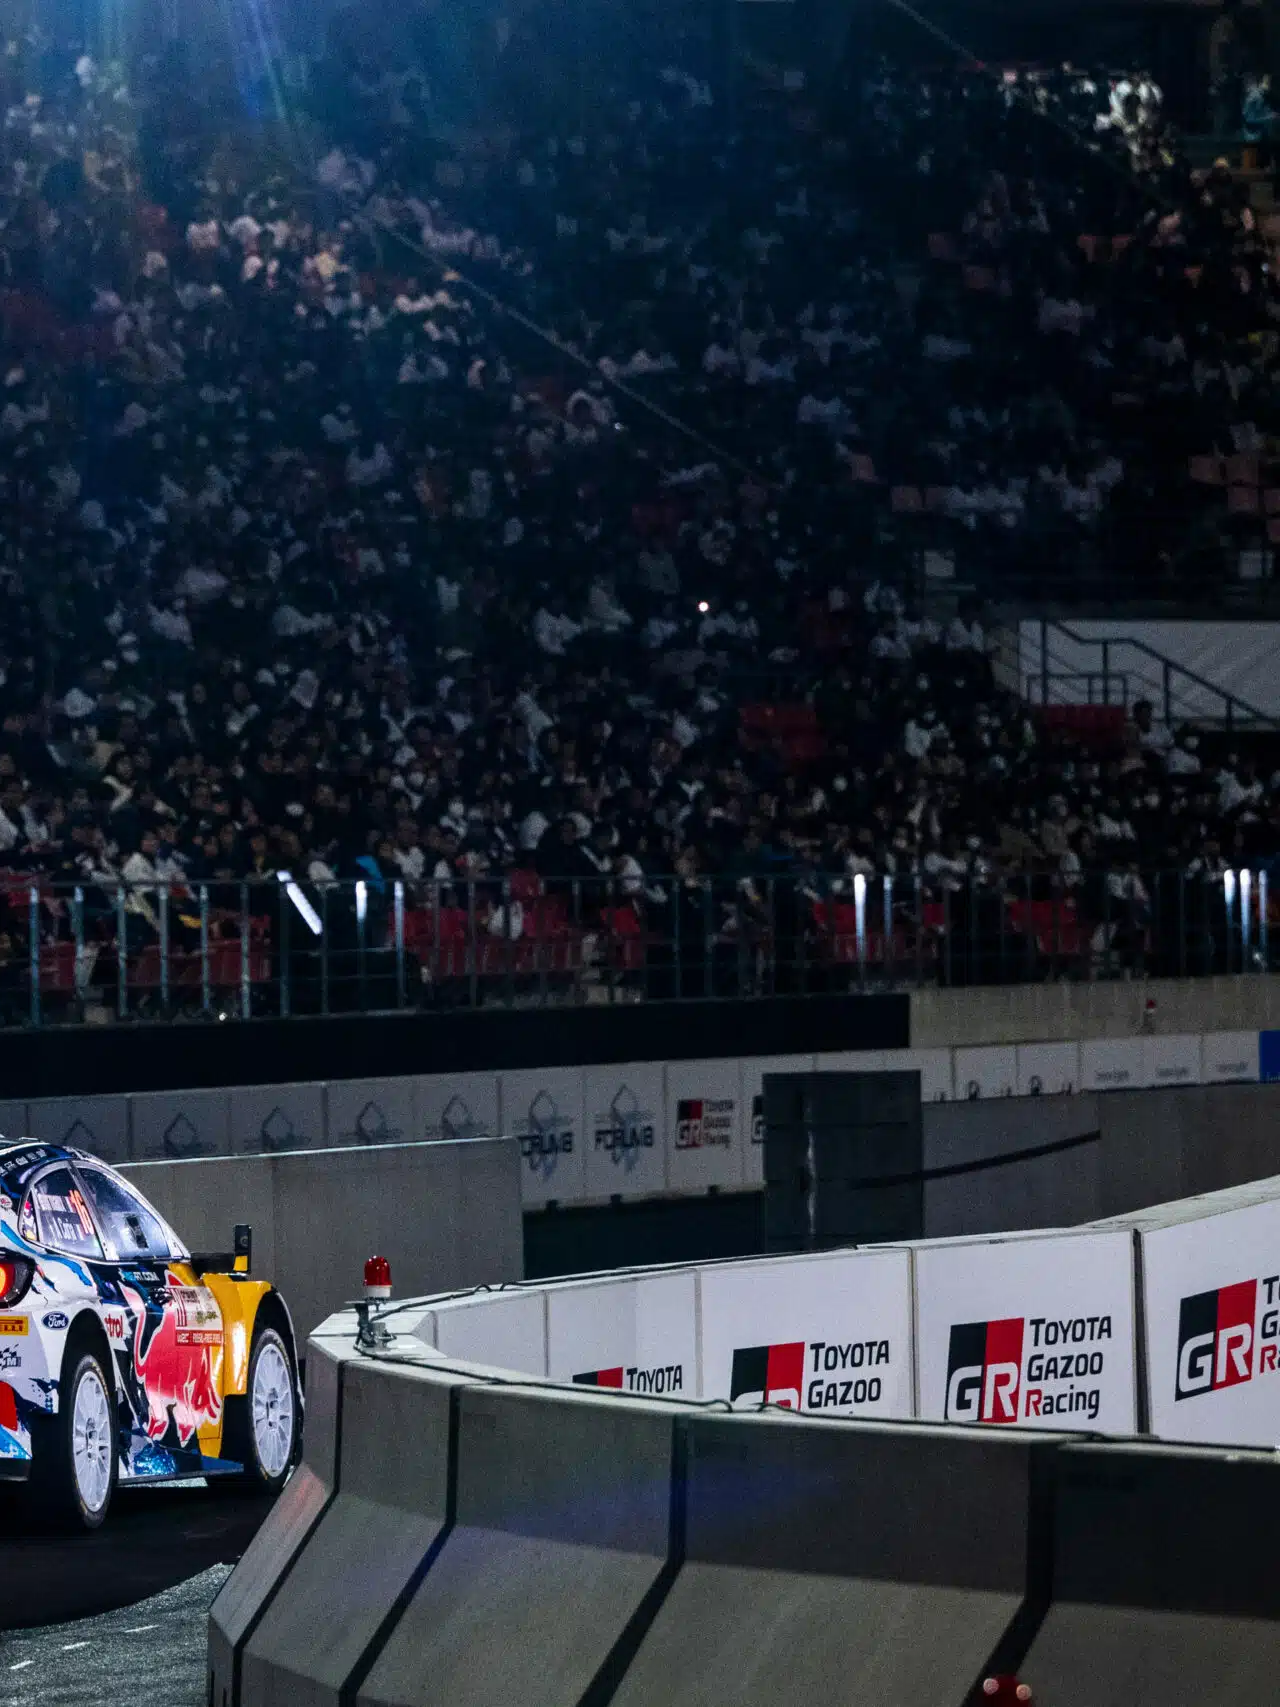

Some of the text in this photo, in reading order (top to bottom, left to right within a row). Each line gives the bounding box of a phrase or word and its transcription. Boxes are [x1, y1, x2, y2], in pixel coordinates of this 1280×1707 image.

[48, 1314, 66, 1328] Ford
[1030, 1316, 1112, 1347] TOYOTA
[810, 1340, 889, 1372] TOYOTA
[1027, 1352, 1103, 1382] GAZOO
[1178, 1322, 1252, 1393] GR
[626, 1365, 682, 1393] TOYOTA
[808, 1377, 882, 1408] GAZOO
[947, 1361, 1019, 1421] GR
[1025, 1384, 1100, 1420] Racing
